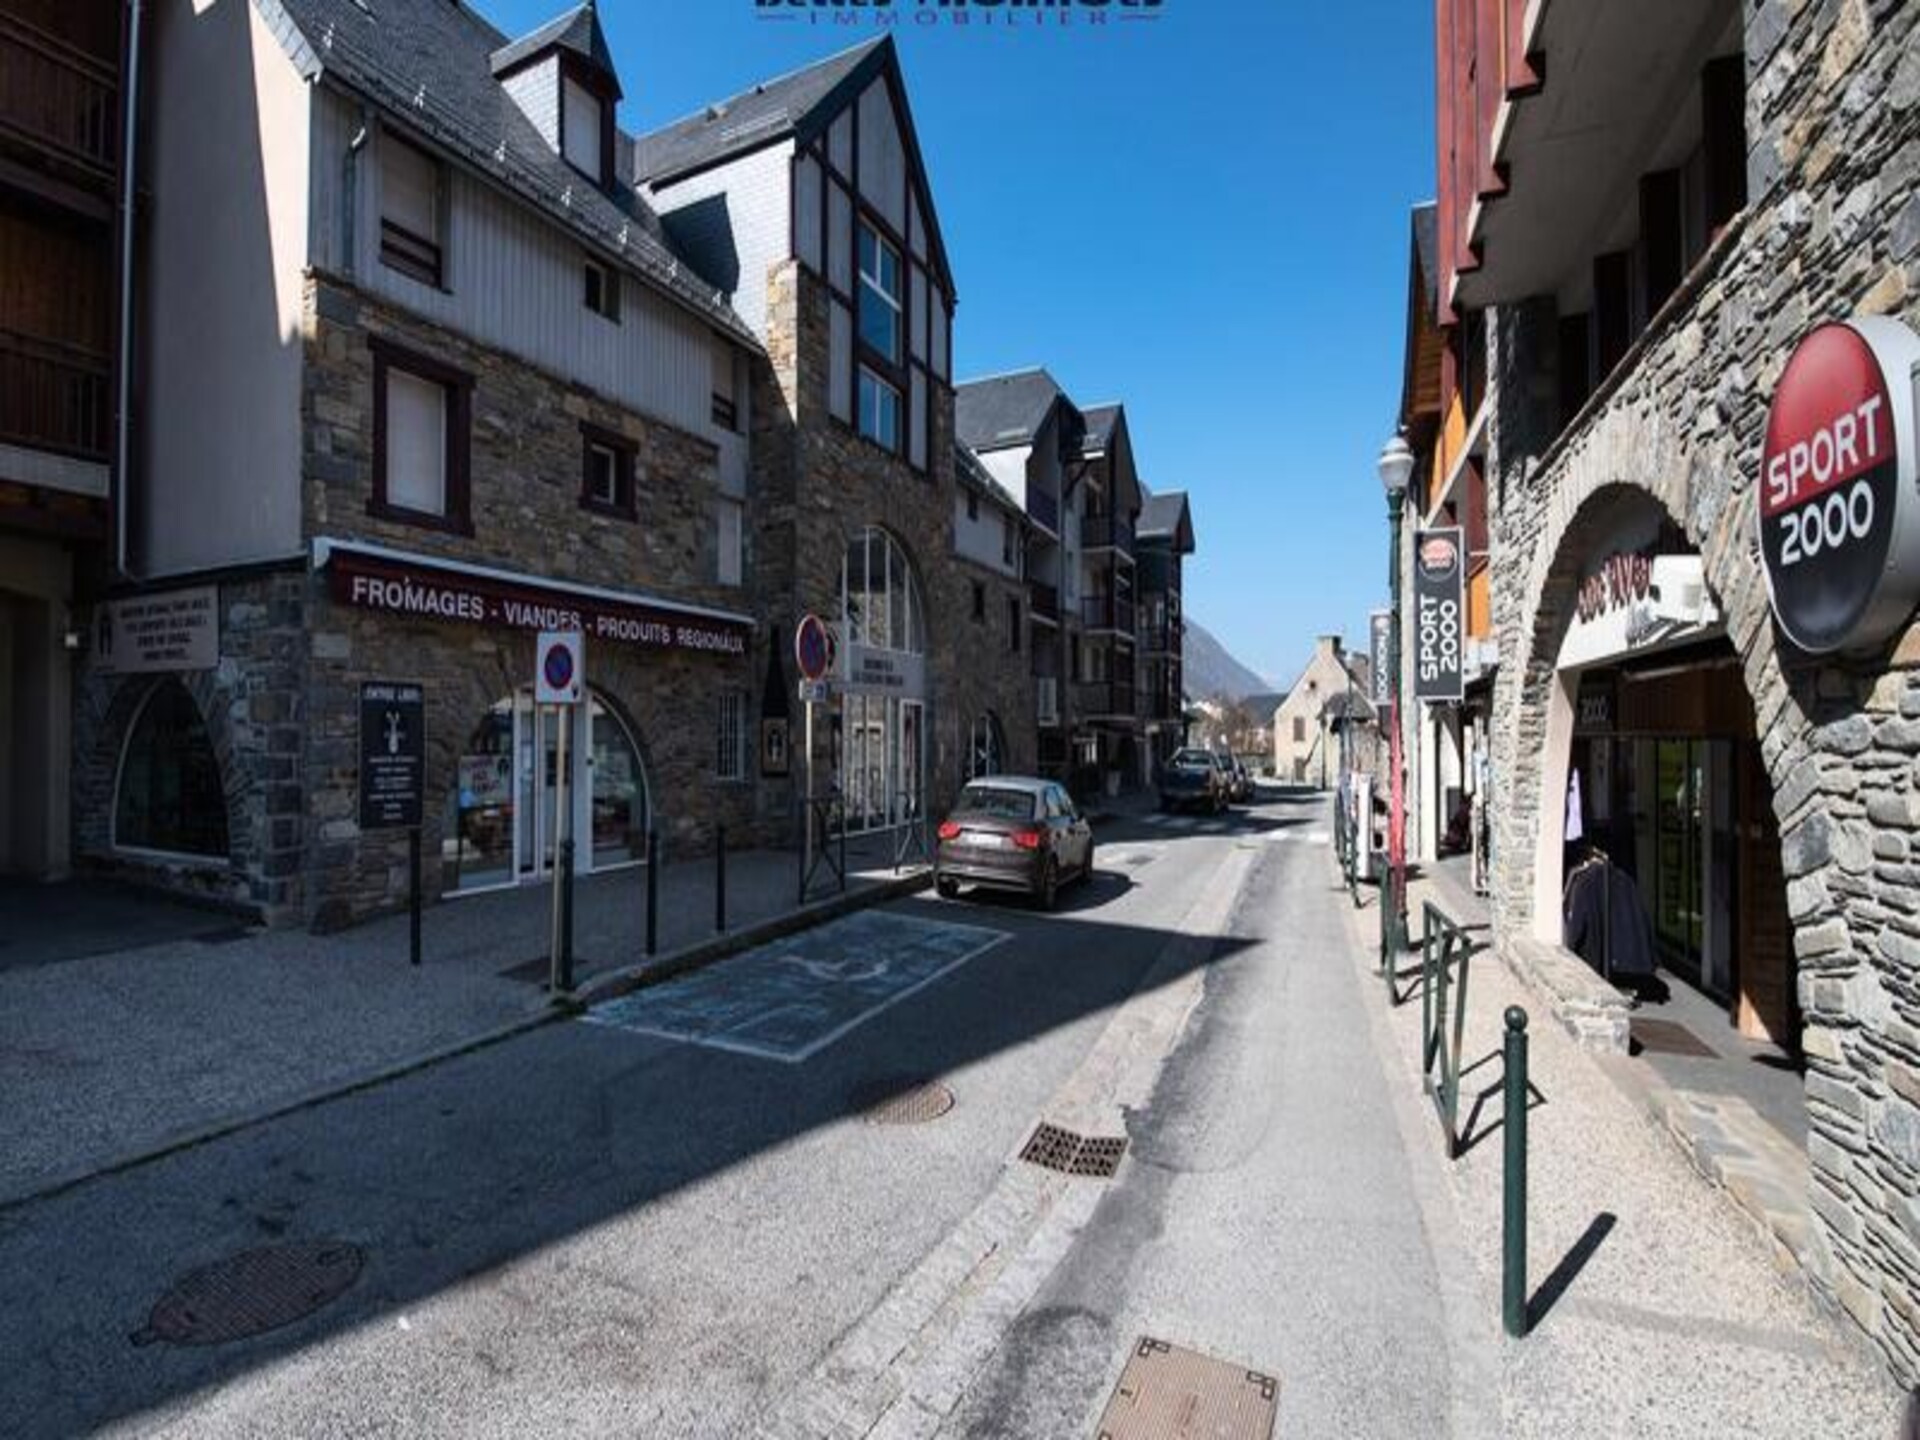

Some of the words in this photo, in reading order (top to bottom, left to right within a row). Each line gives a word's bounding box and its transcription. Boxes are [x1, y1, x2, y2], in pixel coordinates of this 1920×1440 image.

[1767, 395, 1882, 508] SPORT
[1779, 479, 1874, 566] 2000
[352, 576, 484, 620] FROMAGES
[503, 600, 581, 631] VIANDES
[596, 615, 671, 644] PRODUITS
[1420, 594, 1438, 682] SPORT
[1439, 599, 1458, 673] 2000
